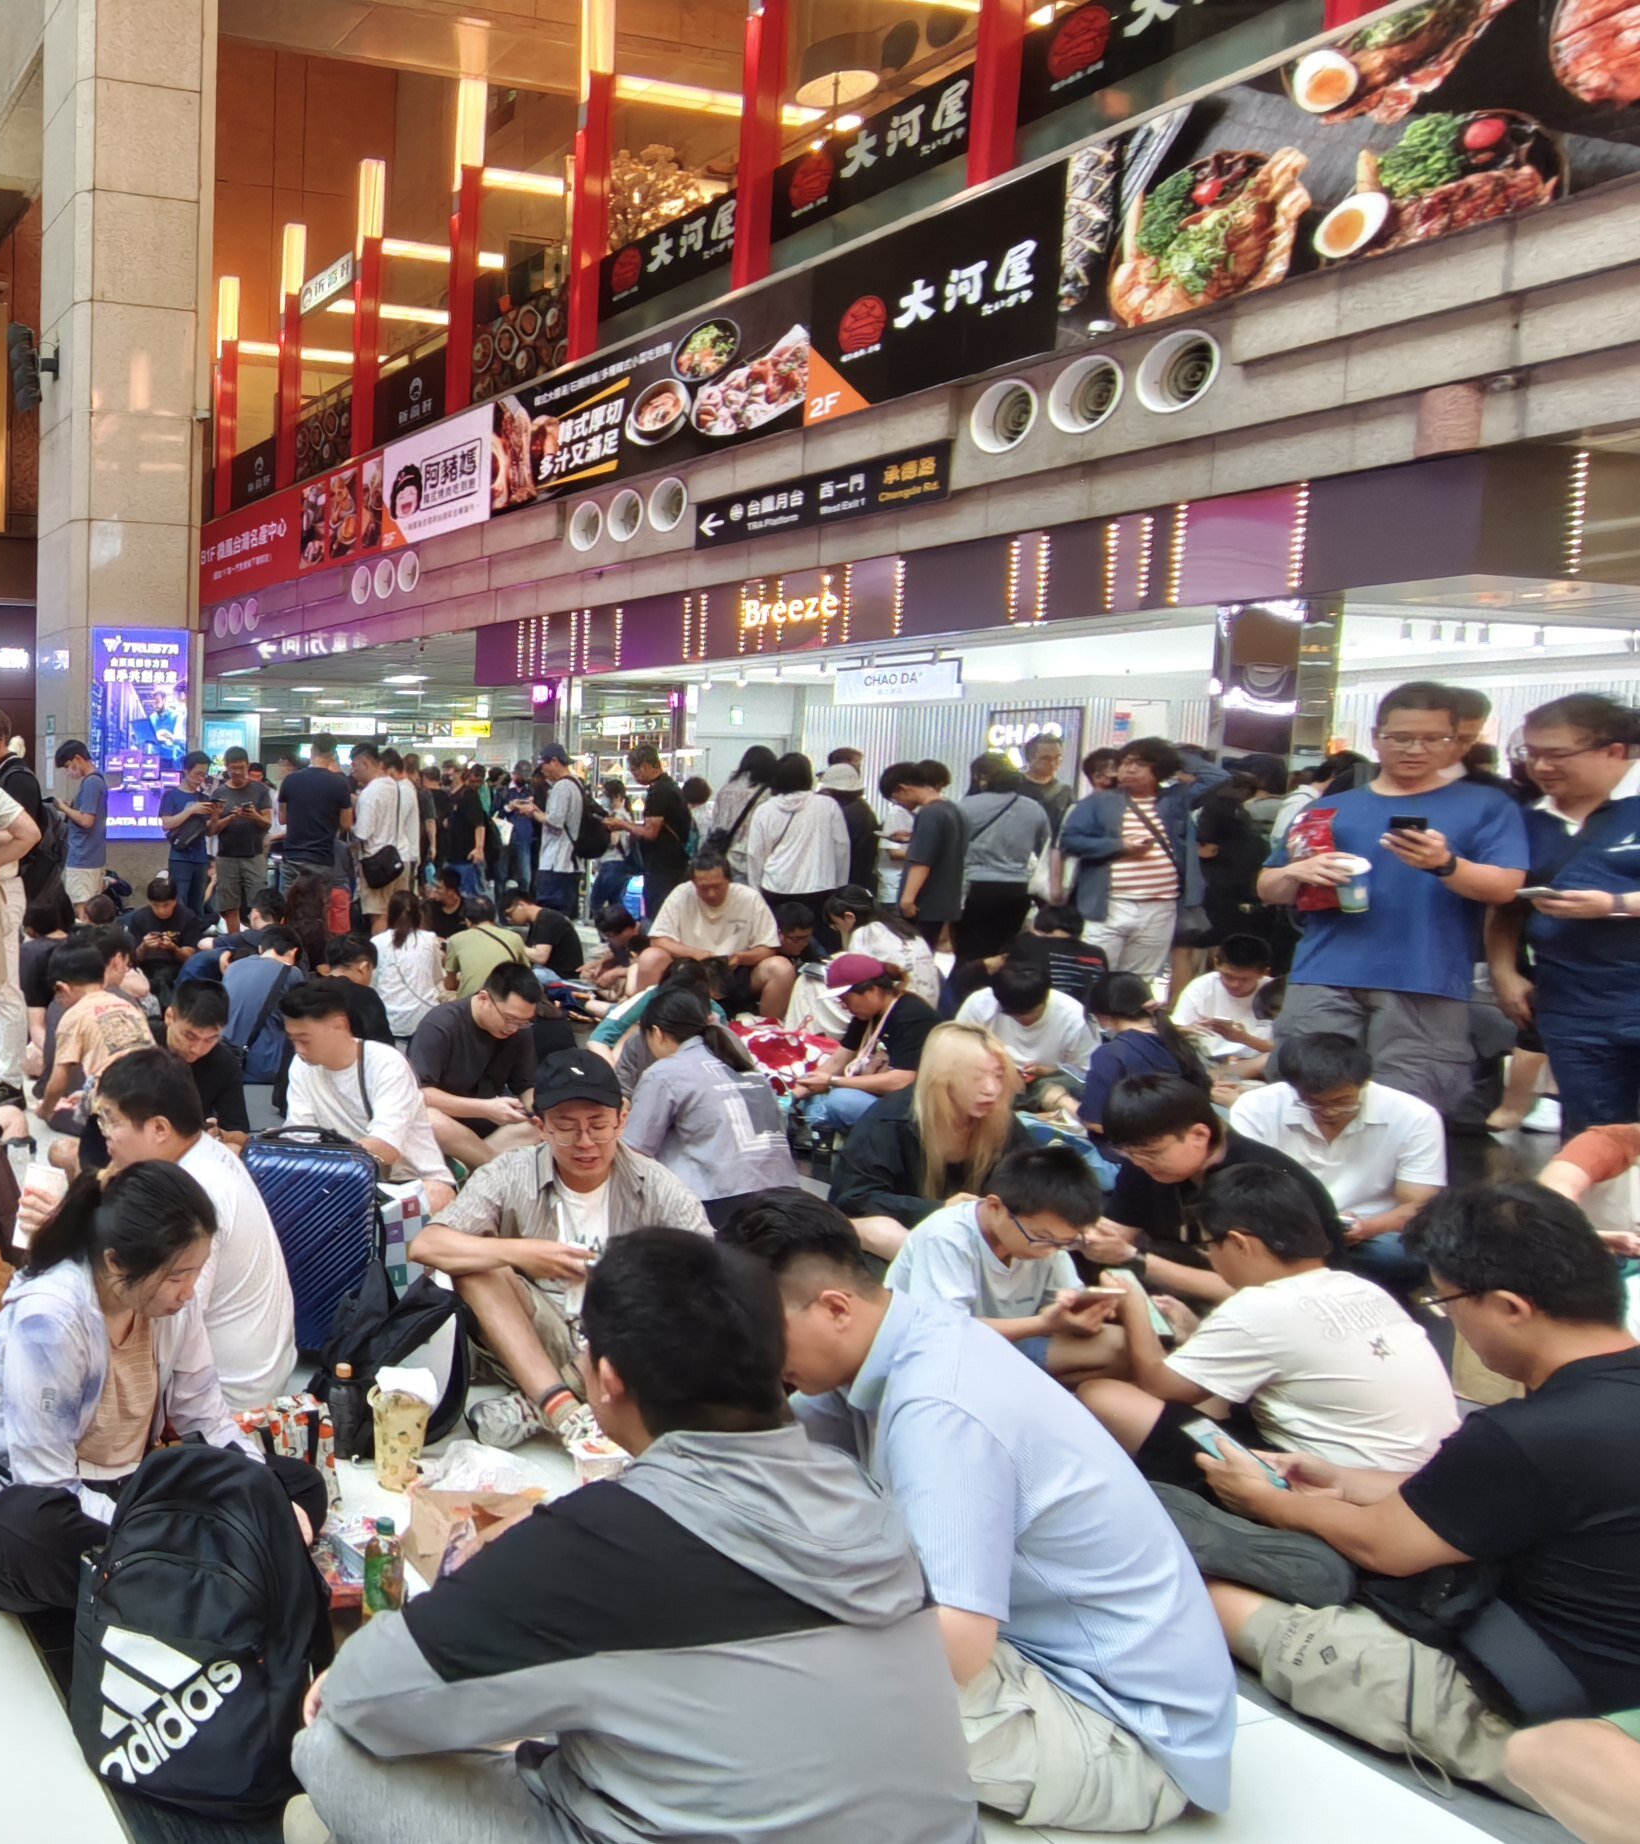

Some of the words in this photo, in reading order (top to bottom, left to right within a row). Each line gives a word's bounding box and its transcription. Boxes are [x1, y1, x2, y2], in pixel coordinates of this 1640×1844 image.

[840, 79, 970, 178] 大河屋
[646, 199, 737, 273] 大河屋
[894, 240, 1037, 329] 大河屋
[558, 398, 625, 445] 韓式厚切
[808, 391, 841, 419] 2F
[424, 446, 478, 492] 阿豬媽
[538, 428, 619, 480] 多汁又滿足
[820, 473, 865, 500] 西一門
[883, 456, 937, 485] 承德路
[382, 532, 396, 547] 2F
[743, 592, 841, 629] Breeze
[123, 642, 179, 655] TRUSTA
[863, 673, 898, 687] CHAO
[901, 672, 918, 684] DA
[99, 1658, 243, 1785] adidas
